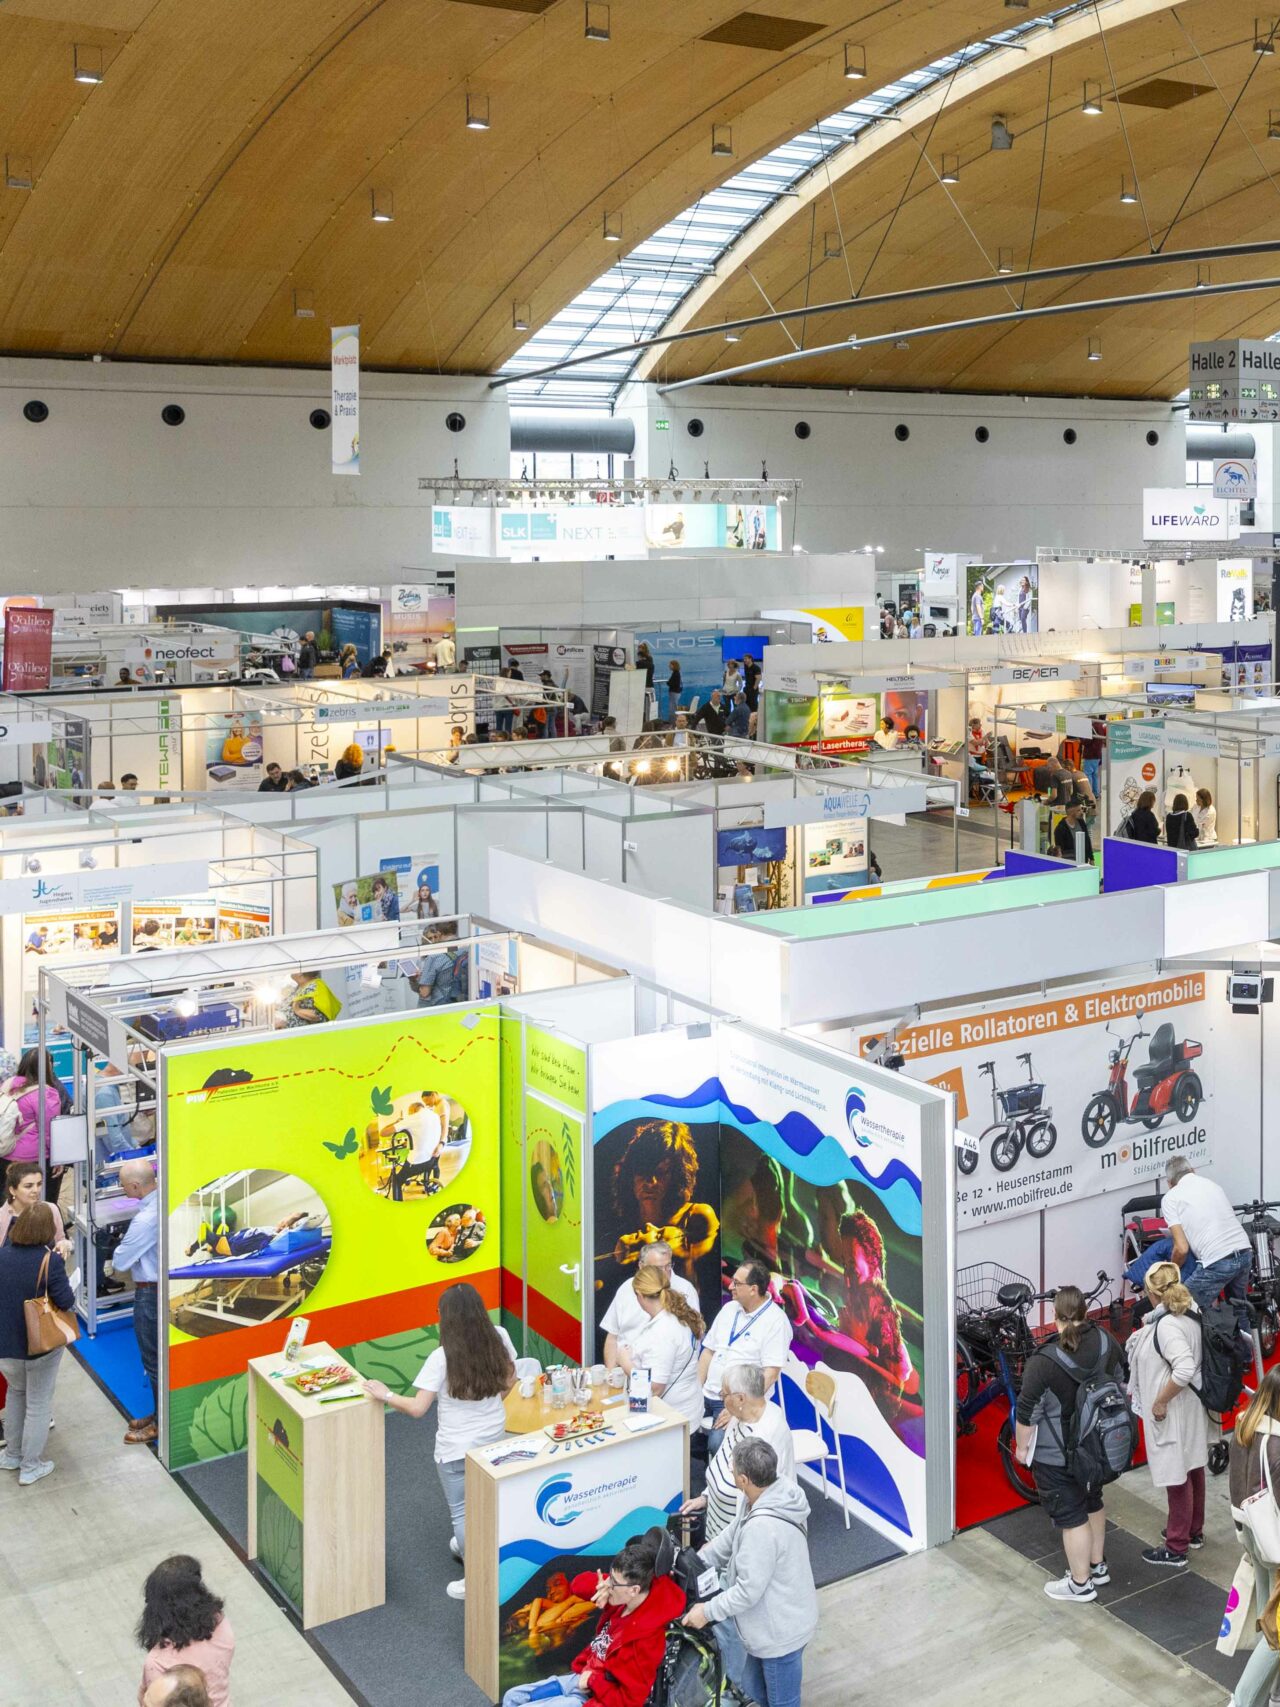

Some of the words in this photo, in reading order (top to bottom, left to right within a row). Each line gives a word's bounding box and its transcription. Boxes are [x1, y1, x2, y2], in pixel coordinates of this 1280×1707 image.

[333, 354, 357, 365] Marktplatz
[1192, 352, 1225, 371] Halle
[1228, 350, 1236, 368] 2
[333, 389, 357, 403] Therapie
[339, 404, 357, 416] Praxis
[1151, 515, 1220, 526] LIFEWARD
[502, 527, 527, 538] SLK
[563, 527, 601, 540] NEXT
[155, 646, 215, 660] neofect
[1013, 667, 1059, 682] BEMER
[329, 707, 357, 718] zebris
[1168, 736, 1218, 750] www.ligasano.com
[823, 793, 859, 812] AQUAWELLE
[862, 1025, 953, 1056] ezielle
[960, 1008, 1058, 1043] Rollatoren
[1064, 1003, 1079, 1023] &
[1084, 979, 1203, 1020] Elektromobile
[860, 1116, 905, 1144] Wassertherapie
[963, 1137, 977, 1151] A46
[1101, 1126, 1207, 1170] mobilfreu.de
[1133, 1160, 1168, 1175] Stilsiche
[972, 1188, 984, 1201] 12
[995, 1163, 1074, 1194] Heusenstamm
[971, 1180, 1074, 1218] www.mobilfreu.de
[564, 1474, 638, 1504] Wassertherapie
